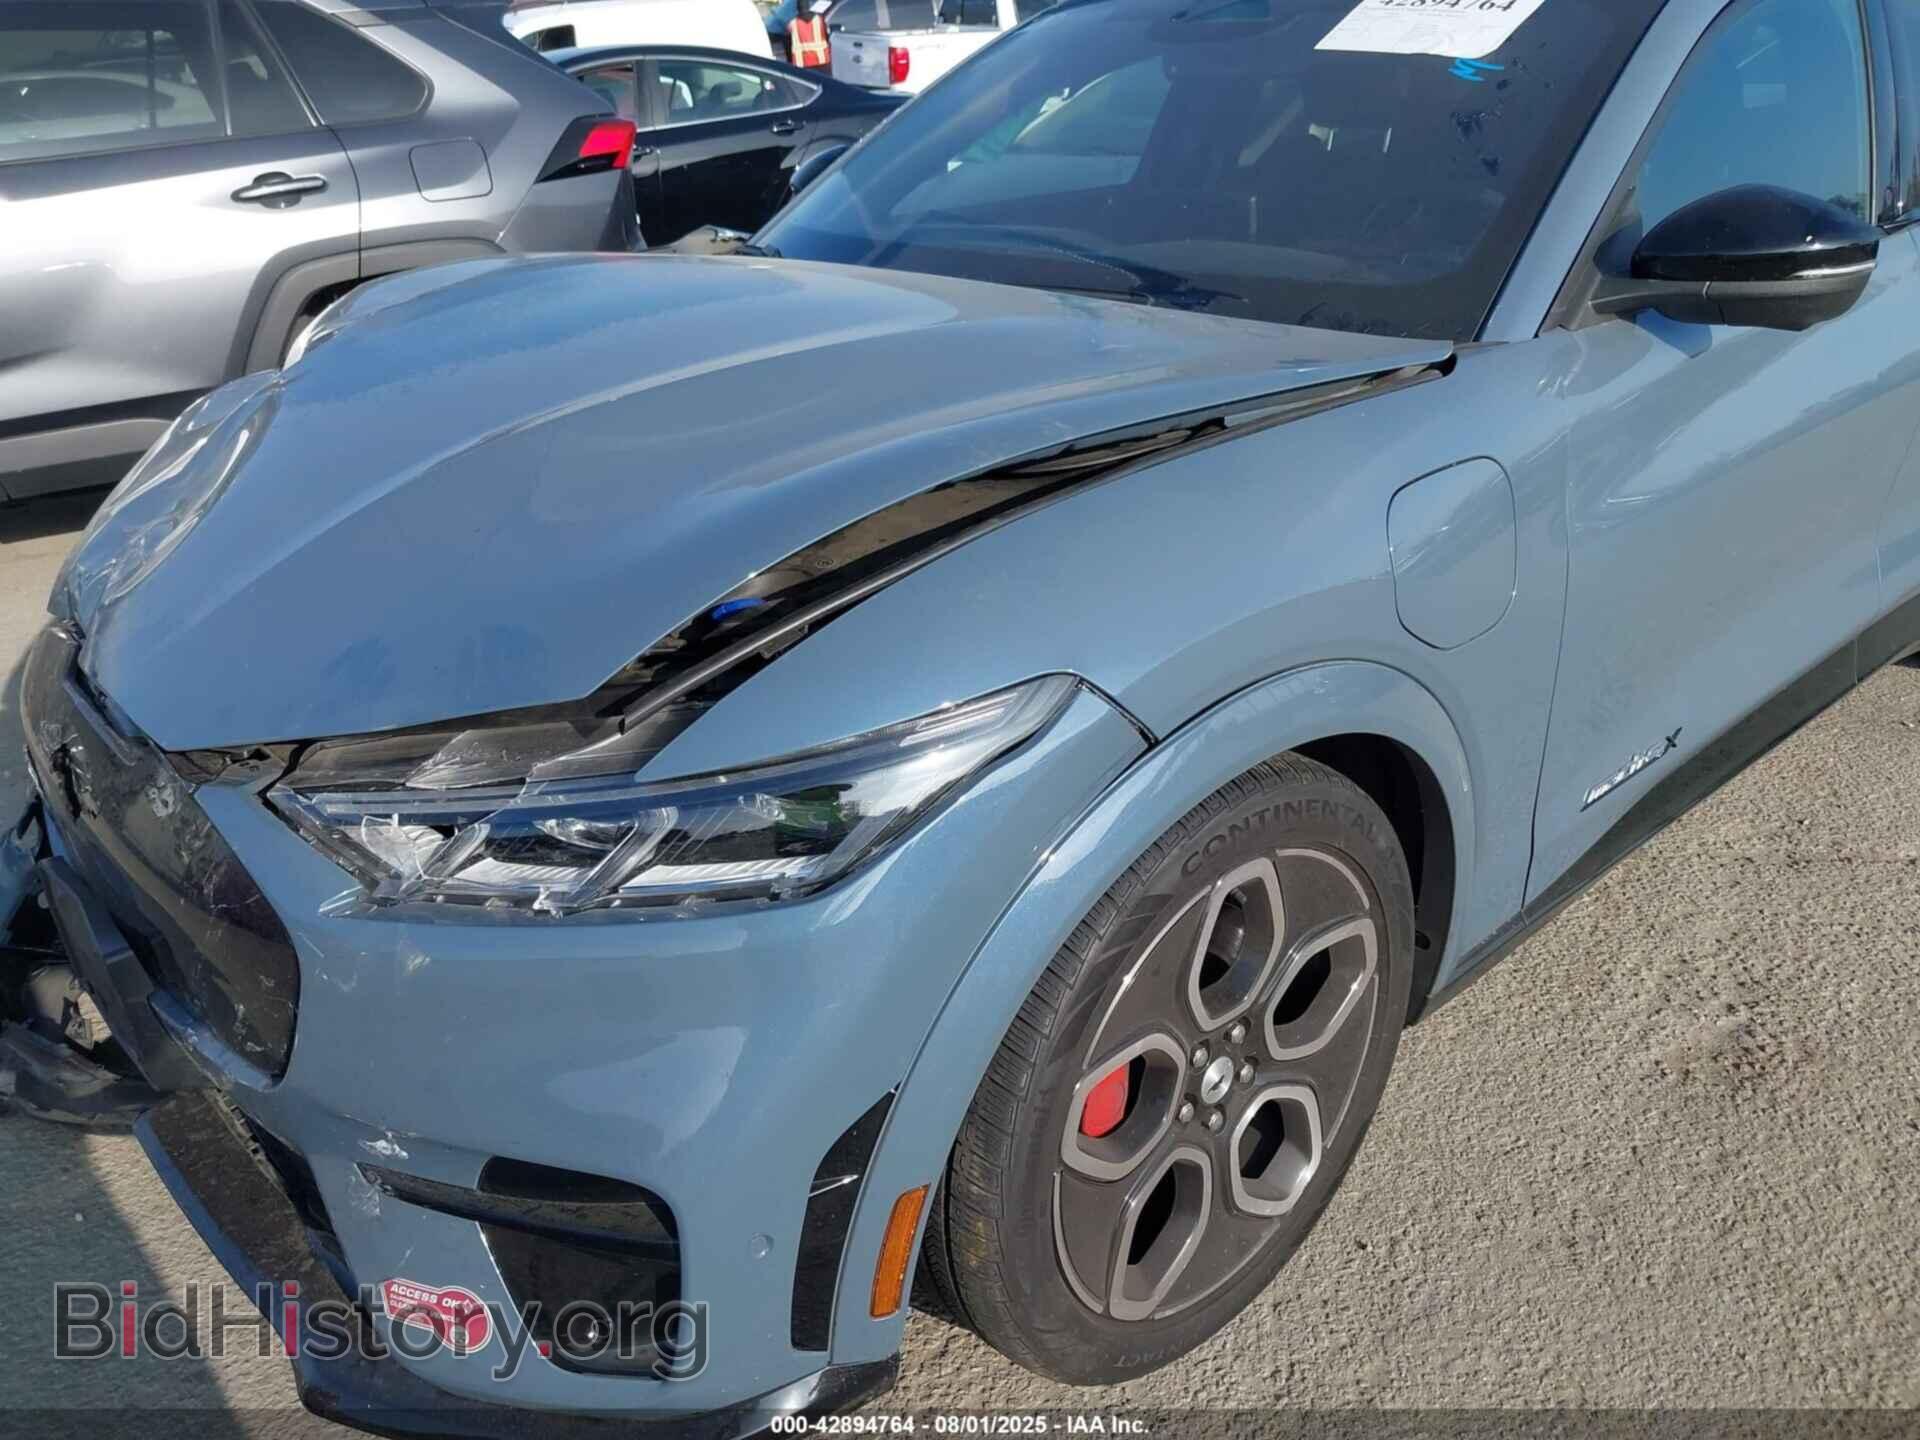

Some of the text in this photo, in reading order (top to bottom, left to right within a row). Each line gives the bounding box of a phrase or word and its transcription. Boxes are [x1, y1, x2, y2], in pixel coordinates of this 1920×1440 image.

[1181, 799, 1382, 877] CONTINENTAL
[390, 1284, 438, 1304] ACCESS
[442, 1297, 462, 1310] OK
